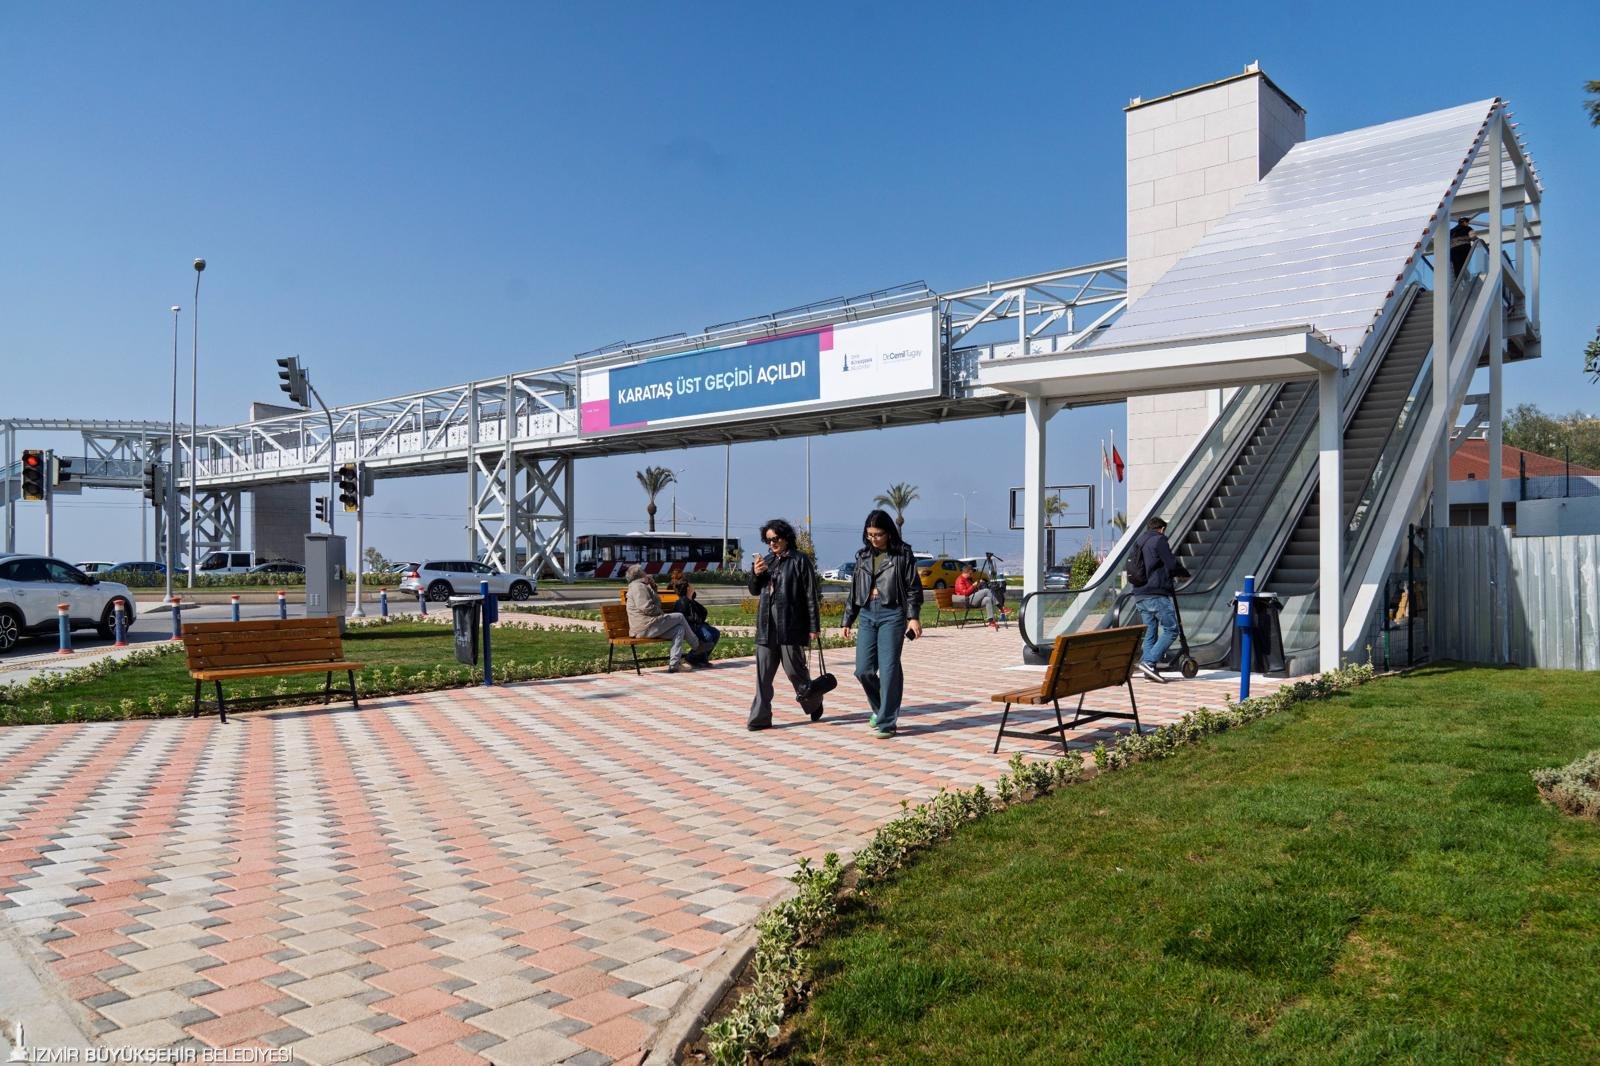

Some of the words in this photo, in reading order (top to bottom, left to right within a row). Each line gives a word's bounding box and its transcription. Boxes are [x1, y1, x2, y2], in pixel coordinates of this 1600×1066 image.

[618, 381, 673, 404] KARATAŞ
[676, 376, 702, 395] ÜST
[704, 365, 753, 391] GEÇİDİ
[756, 360, 806, 385] AÇILDI
